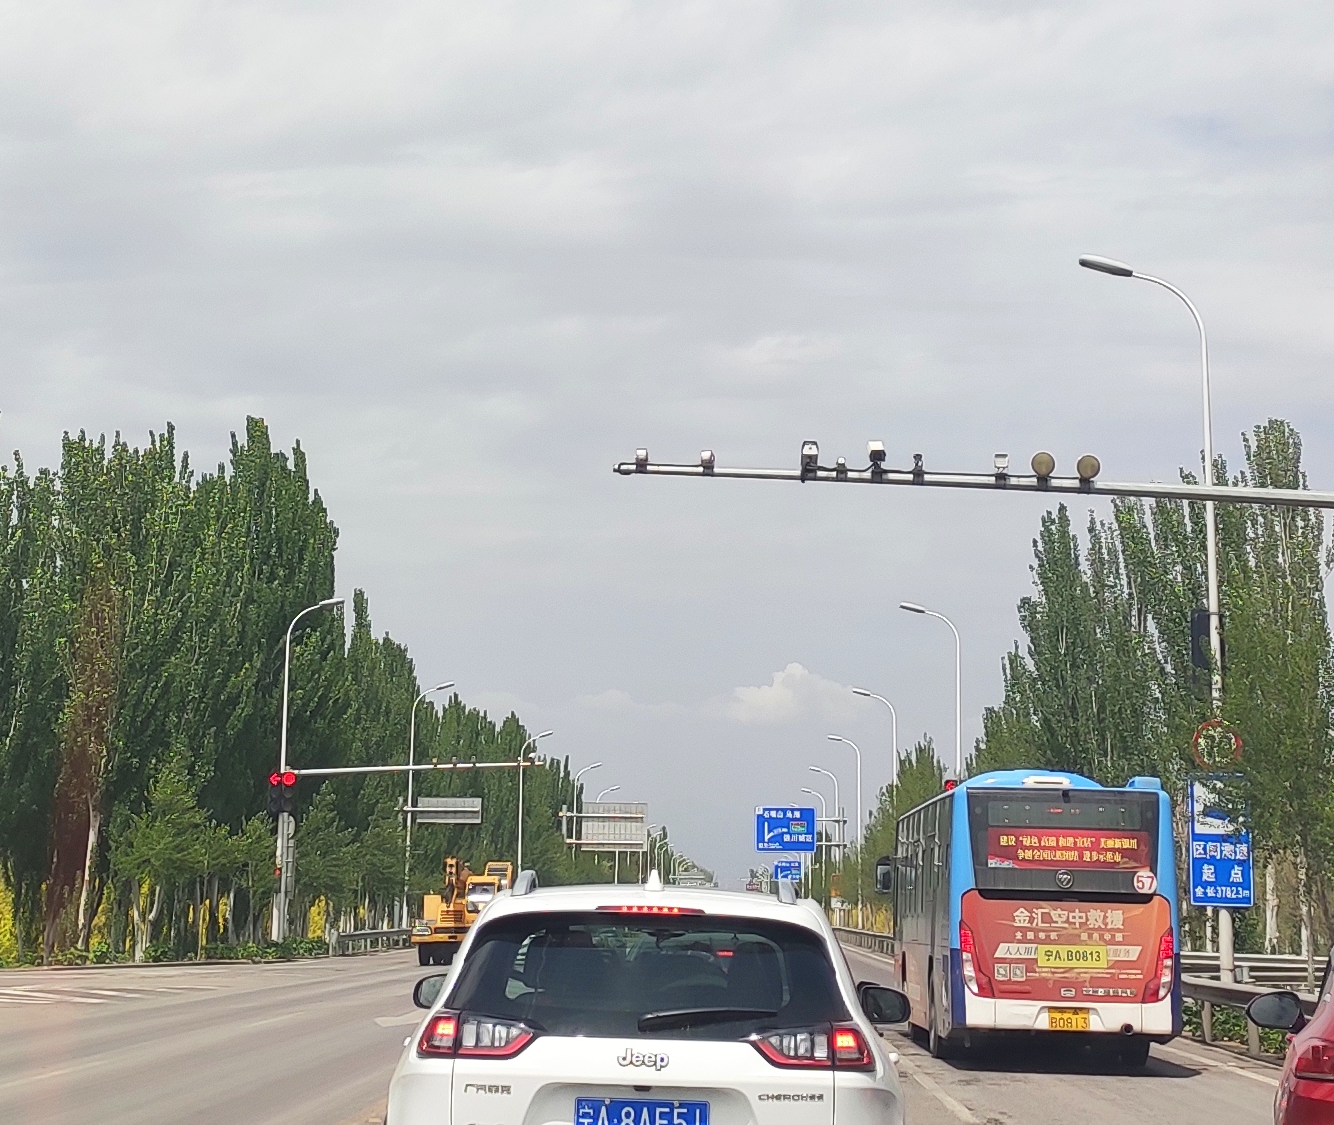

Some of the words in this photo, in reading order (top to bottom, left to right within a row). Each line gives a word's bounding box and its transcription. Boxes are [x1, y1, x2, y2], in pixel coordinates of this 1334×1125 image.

[1192, 841, 1248, 859] 区间测速
[1135, 877, 1154, 891] 57
[1013, 908, 1124, 929] 金汇空中救援
[617, 1048, 670, 1071] Jeep
